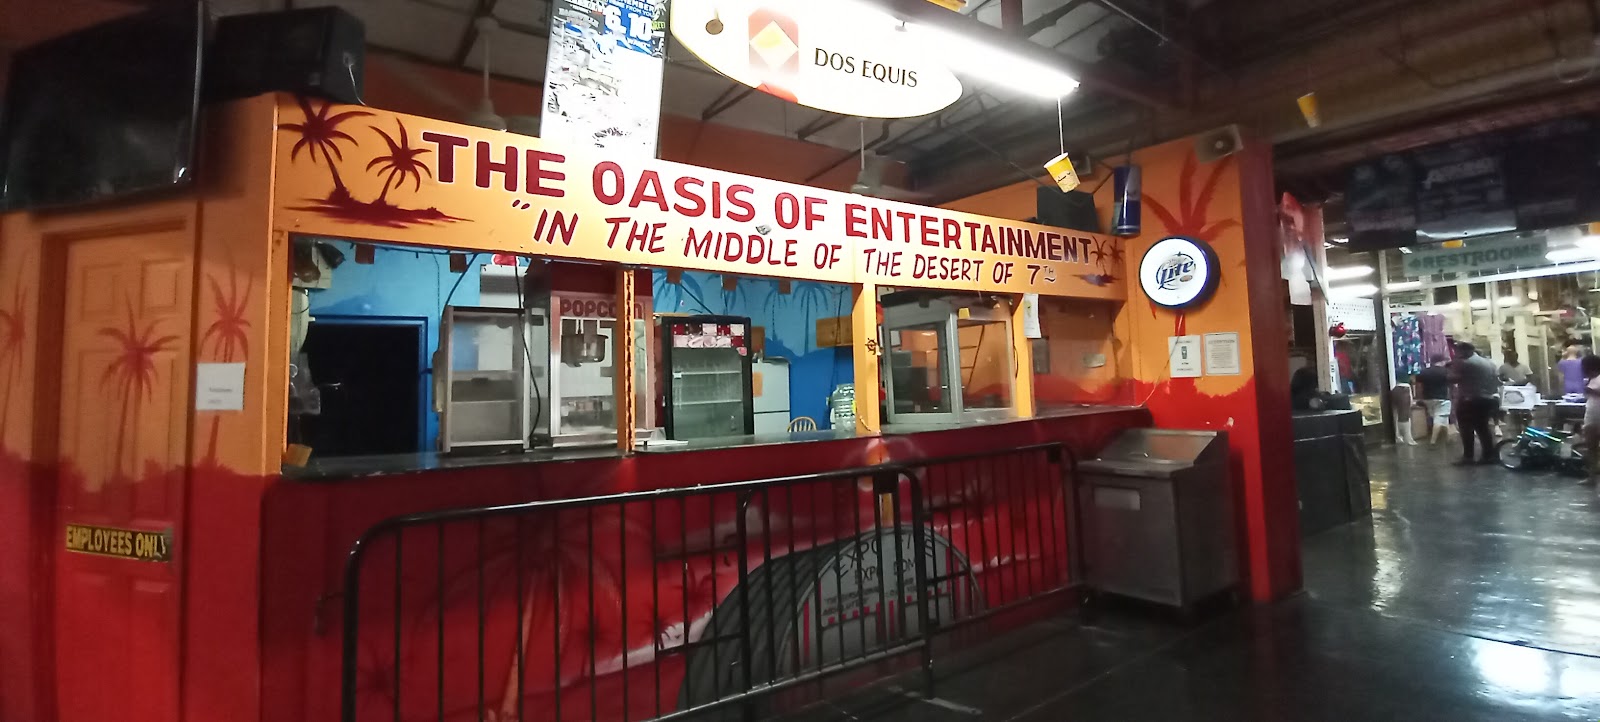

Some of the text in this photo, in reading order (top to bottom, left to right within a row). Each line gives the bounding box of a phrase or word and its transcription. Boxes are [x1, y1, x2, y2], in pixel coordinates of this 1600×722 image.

[628, 12, 653, 42] 10
[814, 47, 918, 88] DOS EQUIS
[422, 131, 1092, 264] THE OASIS OF ENTERTAINMENT
[604, 216, 668, 253] THE
[683, 226, 798, 267] MIDDLE
[814, 242, 843, 270] OF
[863, 248, 902, 278] THE
[912, 253, 984, 283] DESERT
[992, 261, 1014, 285] OF
[1422, 243, 1543, 269] RESTROOMS
[560, 299, 643, 319] POPCON
[65, 525, 133, 556] EMPLOYEES
